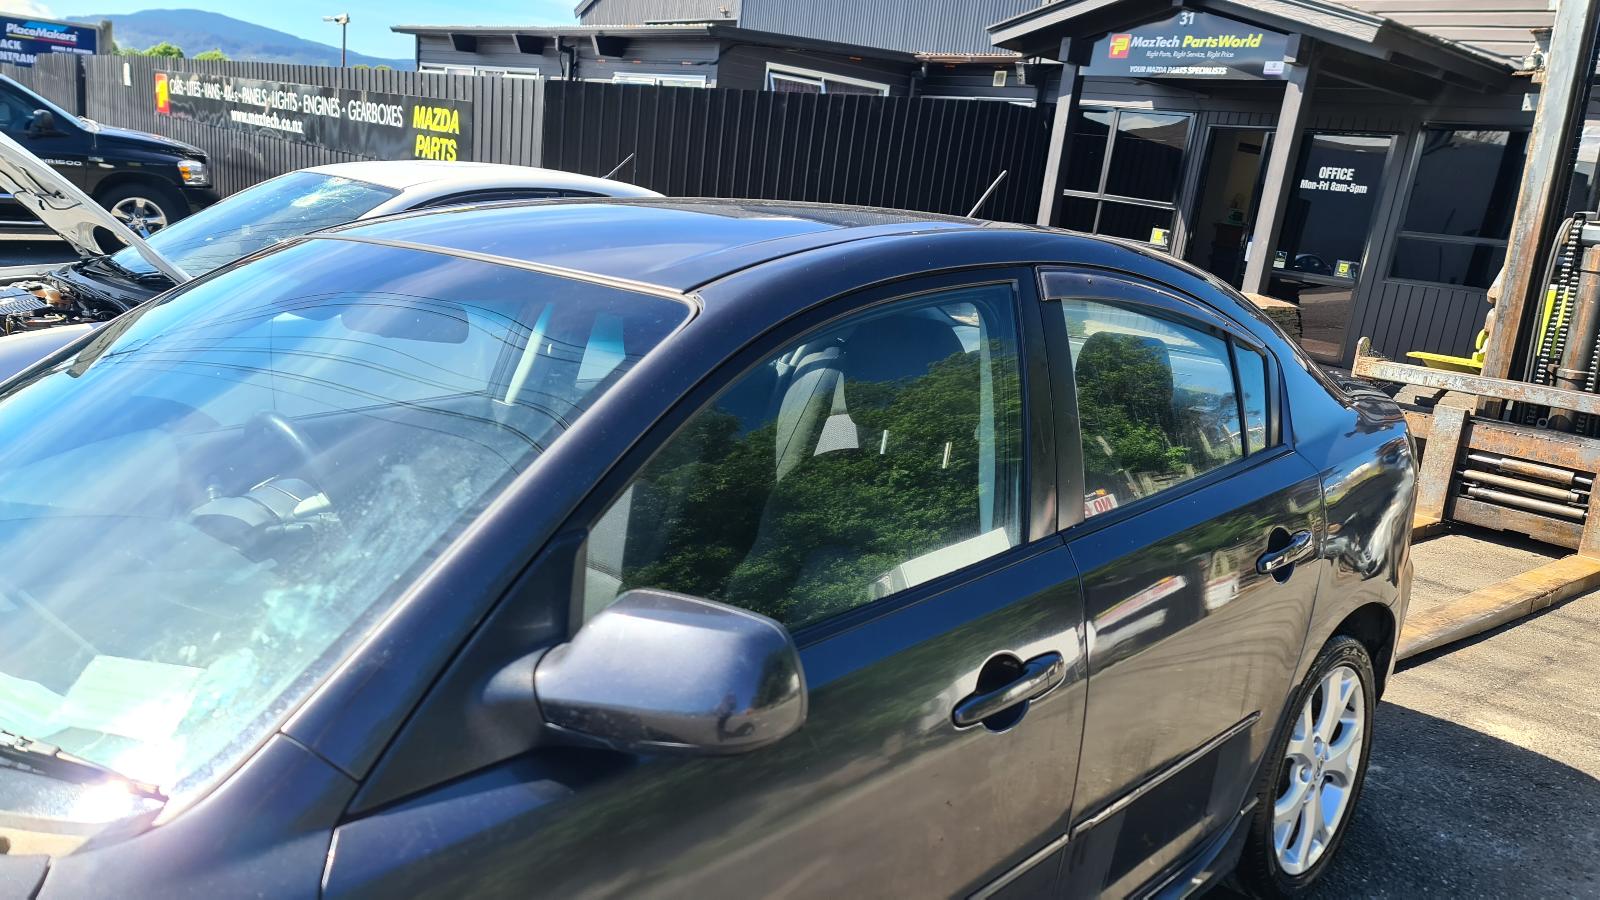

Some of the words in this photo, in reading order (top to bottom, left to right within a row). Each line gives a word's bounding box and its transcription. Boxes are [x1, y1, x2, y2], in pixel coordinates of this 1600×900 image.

[1179, 11, 1195, 25] 31
[6, 22, 77, 41] PlaceMakers
[1130, 35, 1180, 48] MazTech
[1182, 33, 1263, 48] PartsWorld
[1129, 65, 1146, 73] YOUR
[1146, 66, 1167, 74] MAZDA
[241, 86, 267, 107] PANELS
[271, 90, 298, 112] LIGHTS
[303, 94, 340, 118] ENGINES
[348, 99, 404, 128] GEARBOXES
[230, 109, 304, 134] www.maztech.co.nz
[412, 105, 460, 135] MAZDA
[415, 135, 458, 162] PARTS
[1318, 166, 1355, 181] OFFICE
[1300, 179, 1330, 191] Mon-Fri
[1330, 182, 1368, 194] 8am-5pm
